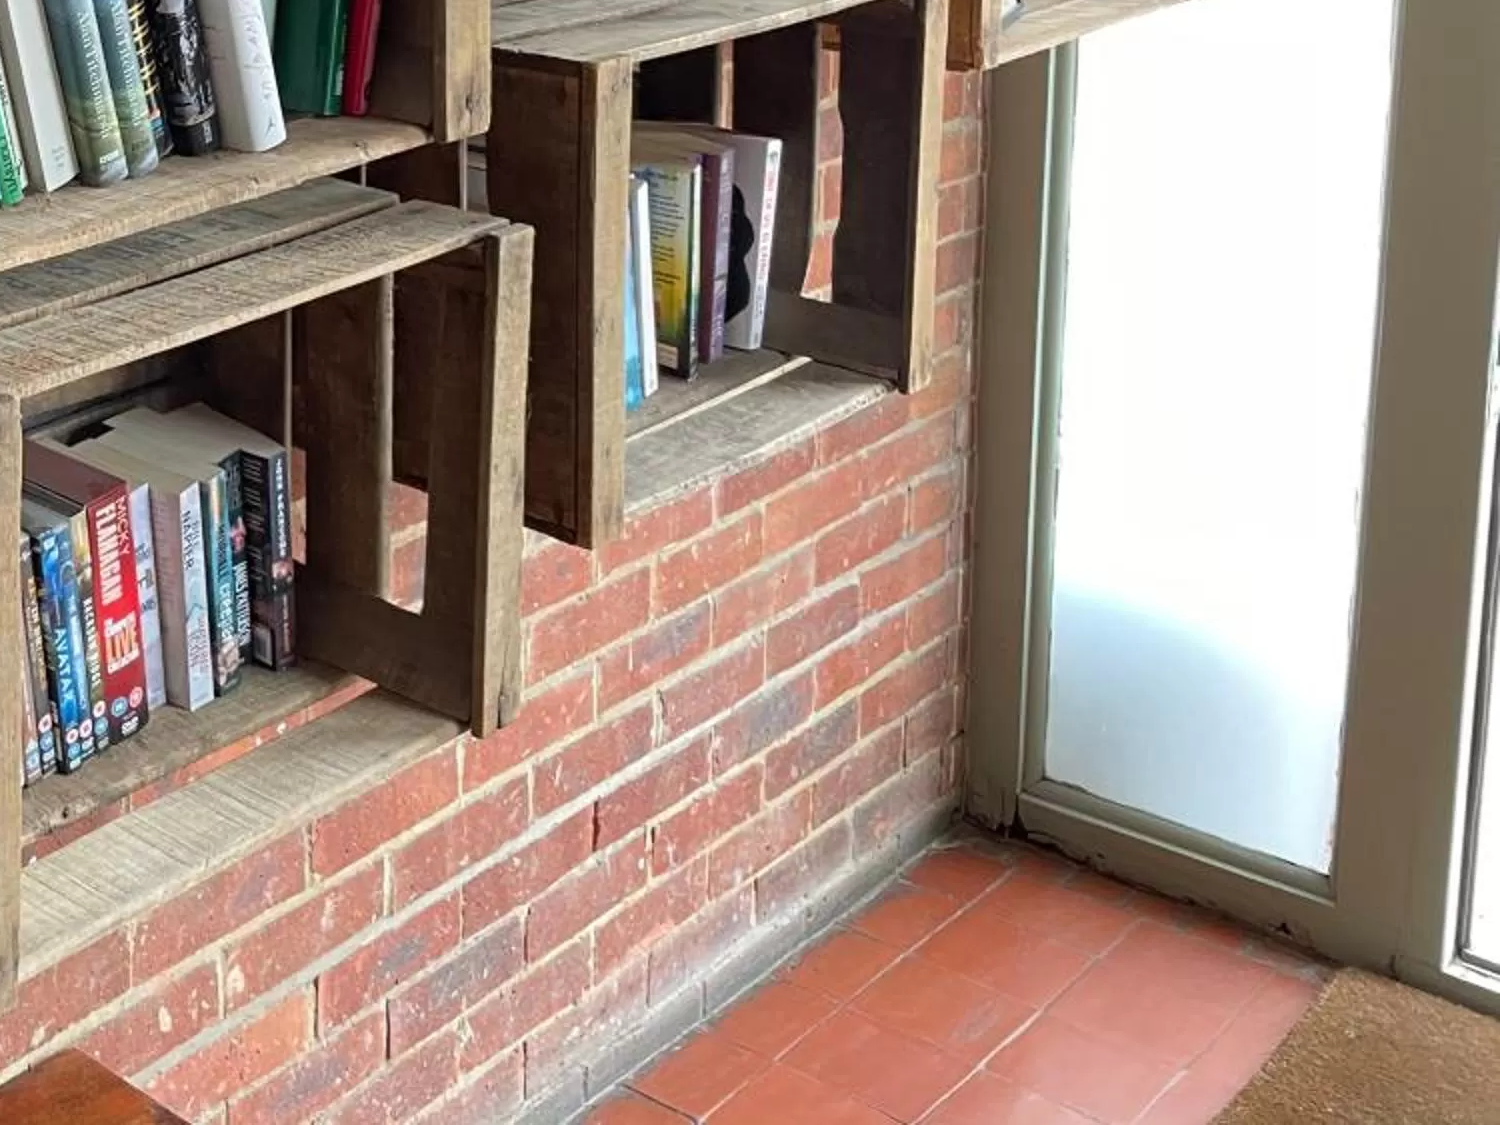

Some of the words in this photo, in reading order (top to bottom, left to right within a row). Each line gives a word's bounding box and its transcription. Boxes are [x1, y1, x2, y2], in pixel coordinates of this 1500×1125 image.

[94, 502, 124, 608] FLANAGAN
[115, 494, 132, 556] MICKY
[53, 627, 77, 702] AVATAR
[106, 623, 138, 661] LIVE
